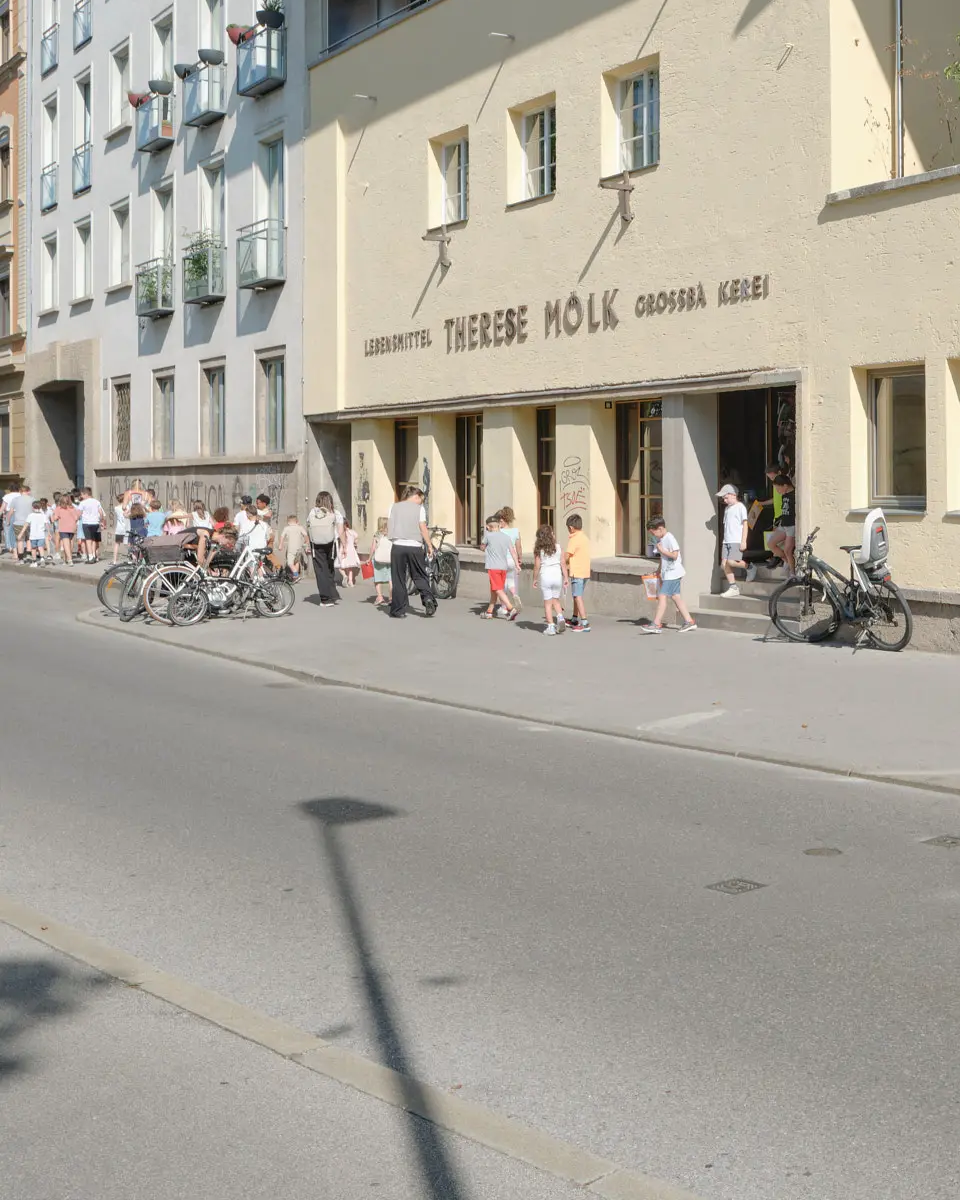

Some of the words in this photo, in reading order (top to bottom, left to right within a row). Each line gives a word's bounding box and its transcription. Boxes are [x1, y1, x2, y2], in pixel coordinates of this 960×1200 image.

[364, 328, 432, 357] LEBENSMITTEL
[444, 305, 528, 354] THERESE
[544, 288, 619, 339] MÖLK
